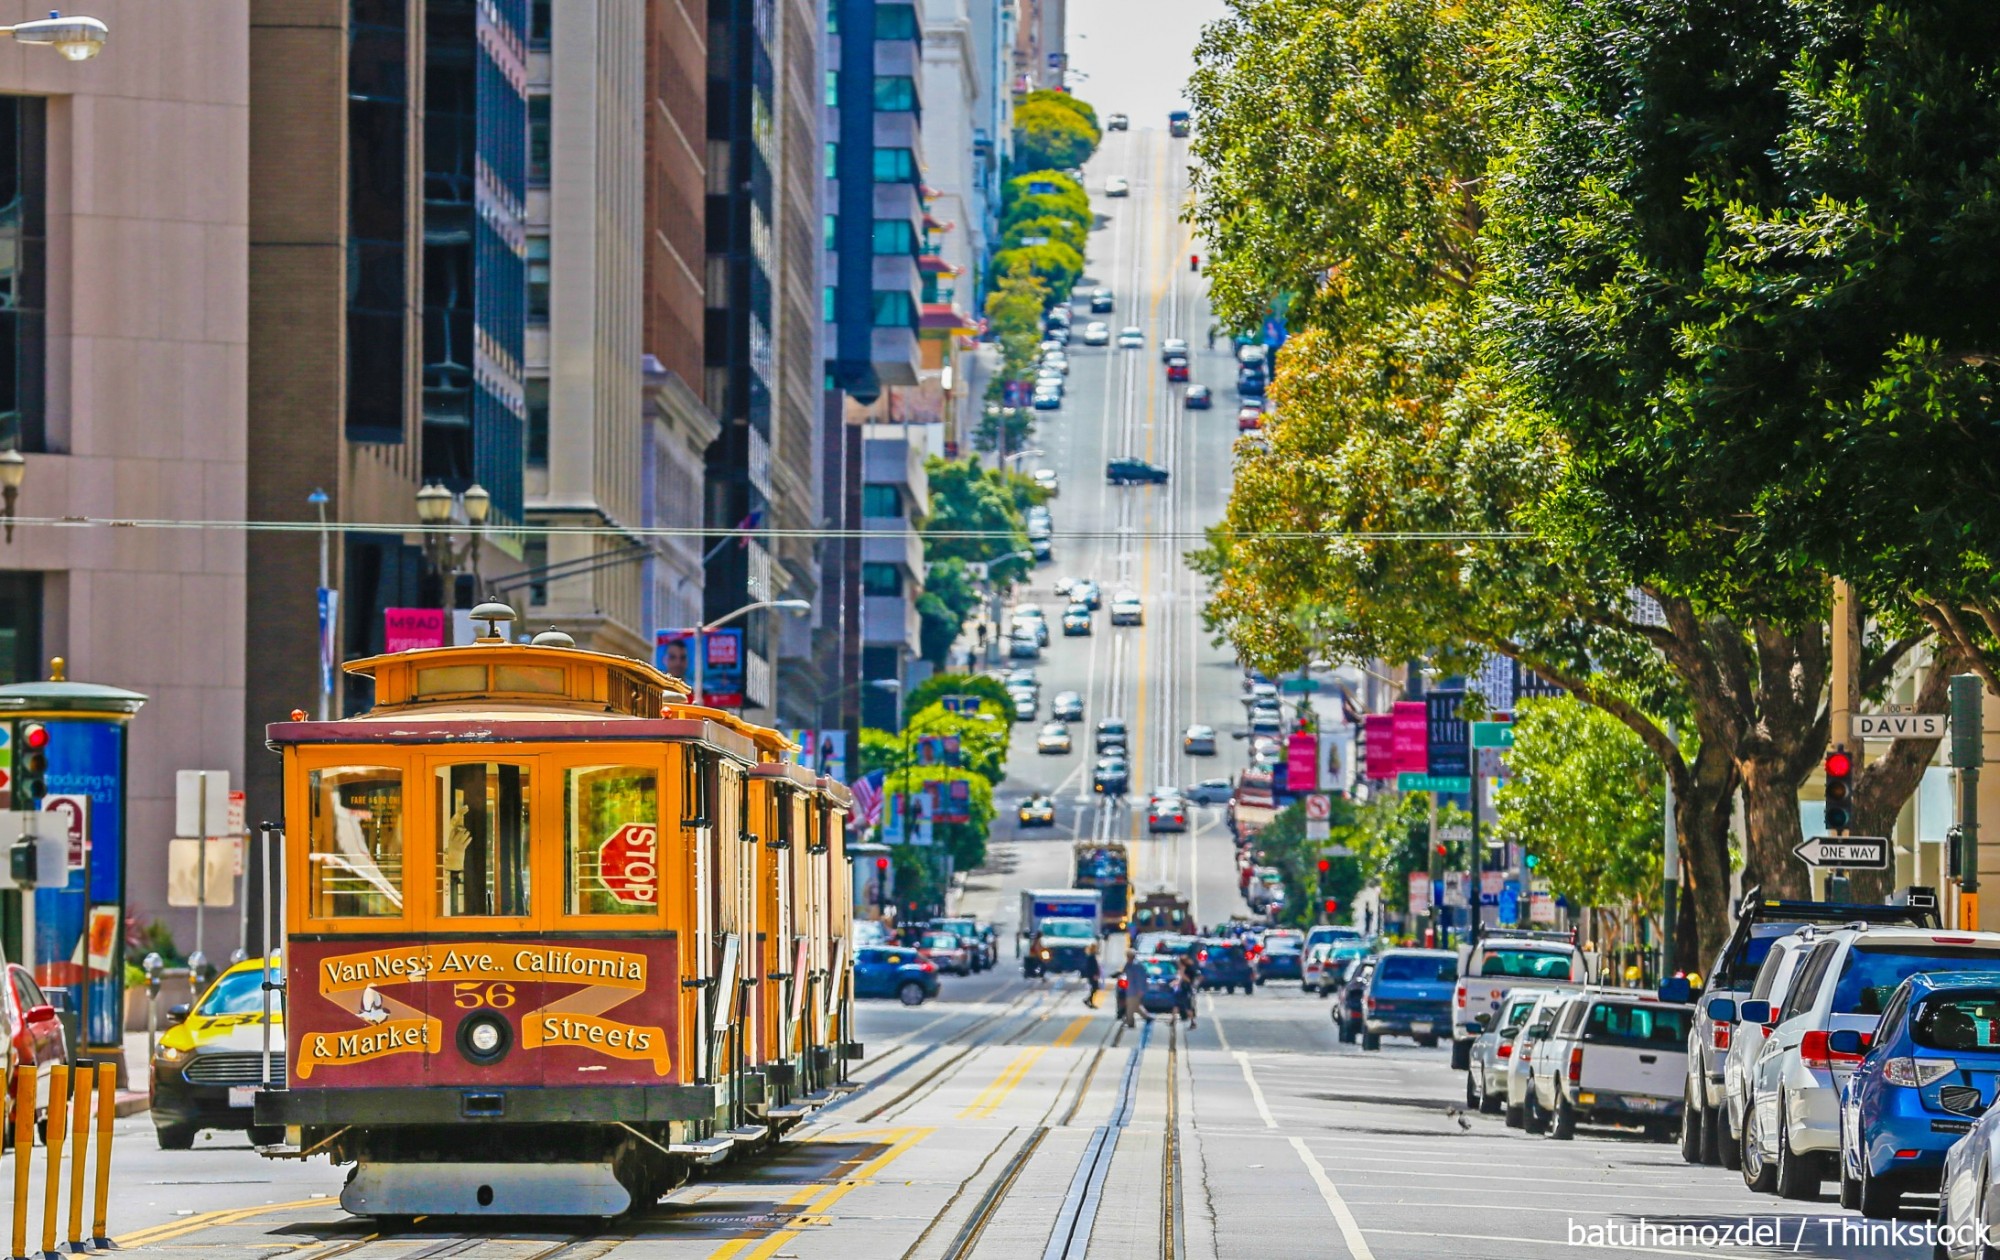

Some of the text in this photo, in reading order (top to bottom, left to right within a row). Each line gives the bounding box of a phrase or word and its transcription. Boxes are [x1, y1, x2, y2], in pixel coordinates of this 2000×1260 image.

[1861, 718, 1935, 733] DAVIS
[625, 827, 656, 900] STOP
[1820, 846, 1876, 859] ONE WAY
[326, 962, 370, 984] Van
[373, 954, 433, 978] Ness
[514, 950, 641, 980] California
[454, 982, 516, 1009] 56
[313, 1023, 430, 1058] & Market
[543, 1017, 651, 1051] Streets
